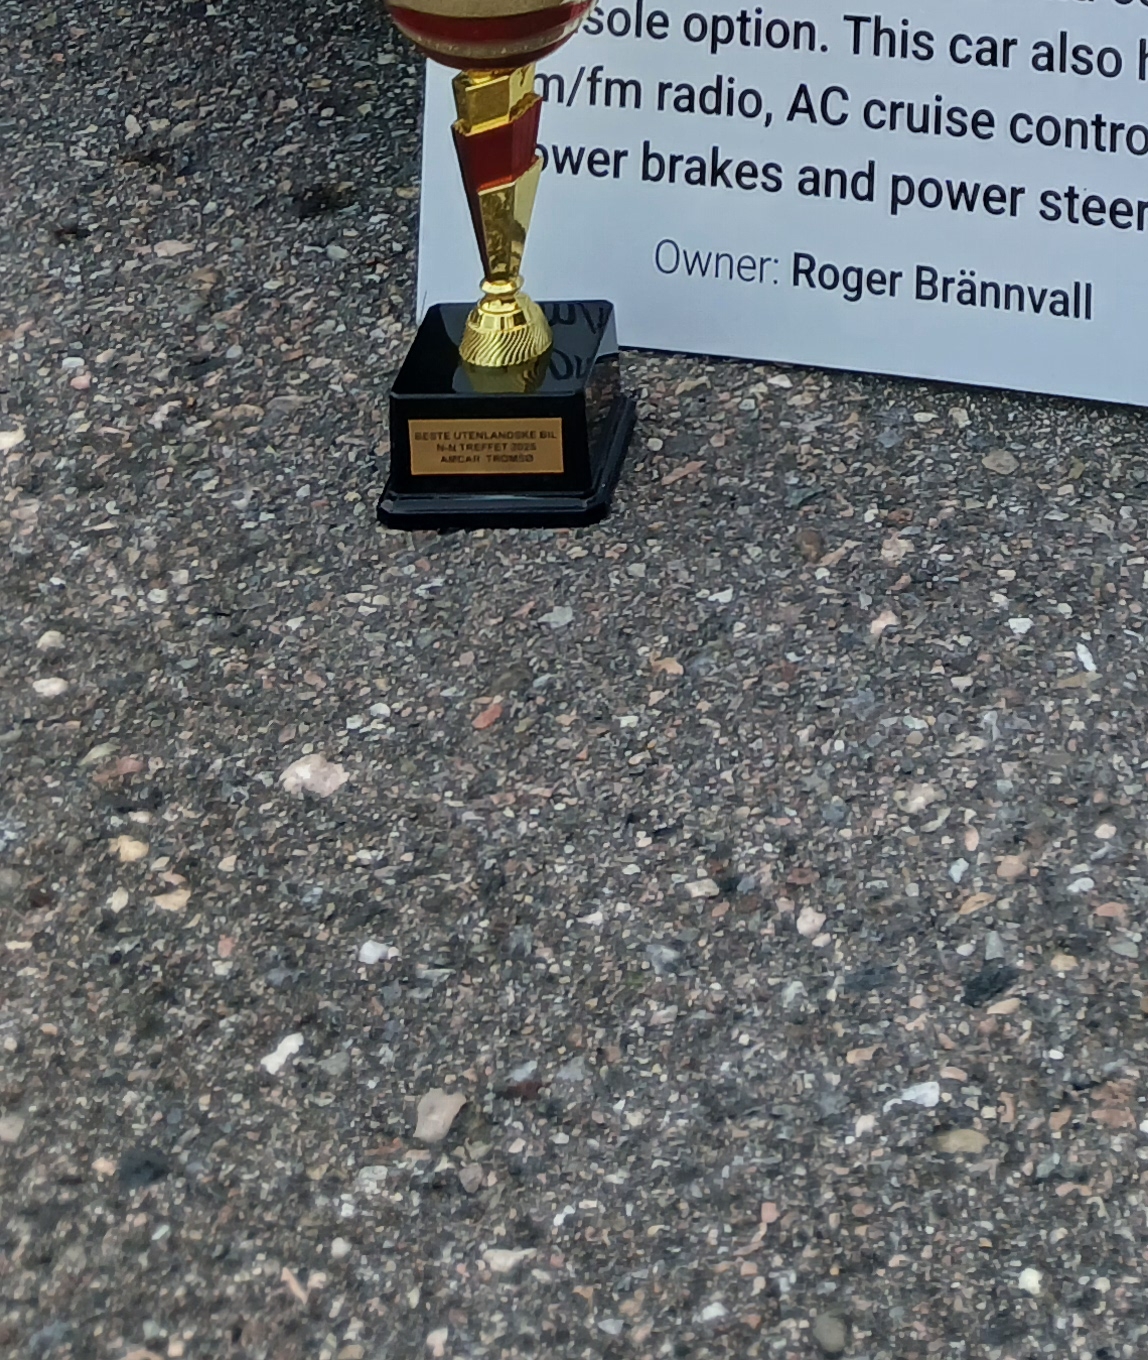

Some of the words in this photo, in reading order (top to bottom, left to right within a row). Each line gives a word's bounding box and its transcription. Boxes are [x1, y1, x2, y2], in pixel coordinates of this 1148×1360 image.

[684, 7, 828, 54] option.
[843, 15, 934, 61] This
[949, 34, 1017, 68] car
[1032, 31, 1122, 78] also
[535, 65, 641, 109] m/fm
[657, 74, 772, 128] radio,
[787, 83, 849, 126] AC
[864, 95, 995, 140] cruise
[536, 143, 628, 179] ower
[642, 140, 782, 192] brakes
[798, 160, 875, 202] and
[891, 174, 1025, 217] power
[655, 239, 779, 284] Owner:
[793, 252, 902, 302] Roger
[916, 265, 1092, 320] Brännvall
[459, 442, 507, 451] TREFFET
